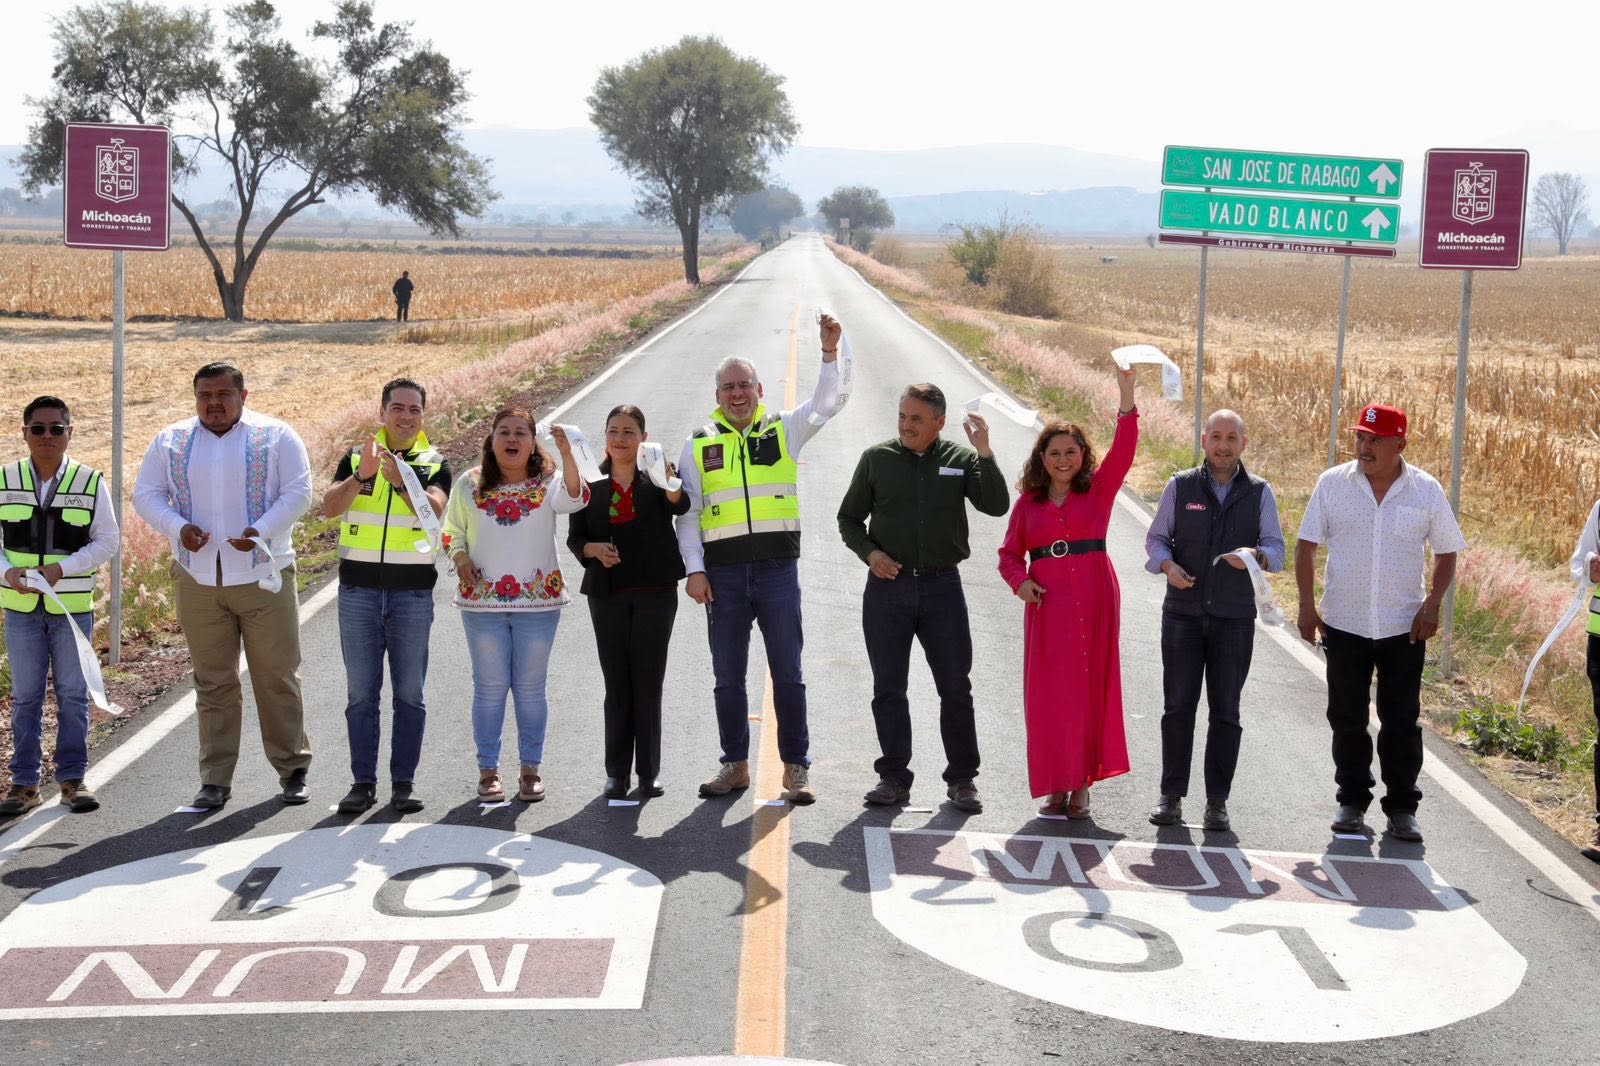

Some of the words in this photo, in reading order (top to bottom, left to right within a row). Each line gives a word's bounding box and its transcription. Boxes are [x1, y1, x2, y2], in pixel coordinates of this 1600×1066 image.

[1202, 157, 1232, 180] SAN
[1237, 160, 1272, 183] JOSE
[1278, 162, 1296, 184] DE
[1301, 164, 1360, 188] RABAGO
[82, 209, 151, 224] Michoacán
[1209, 201, 1259, 227] VADO
[1268, 206, 1348, 232] BLANCO
[1218, 239, 1264, 249] Gobierno
[1283, 243, 1335, 253] Michoacán
[1437, 232, 1505, 244] Michoacán
[966, 835, 1358, 900] MUN
[210, 862, 520, 921] 01
[1021, 911, 1351, 991] 01
[46, 943, 529, 1001] MUN
